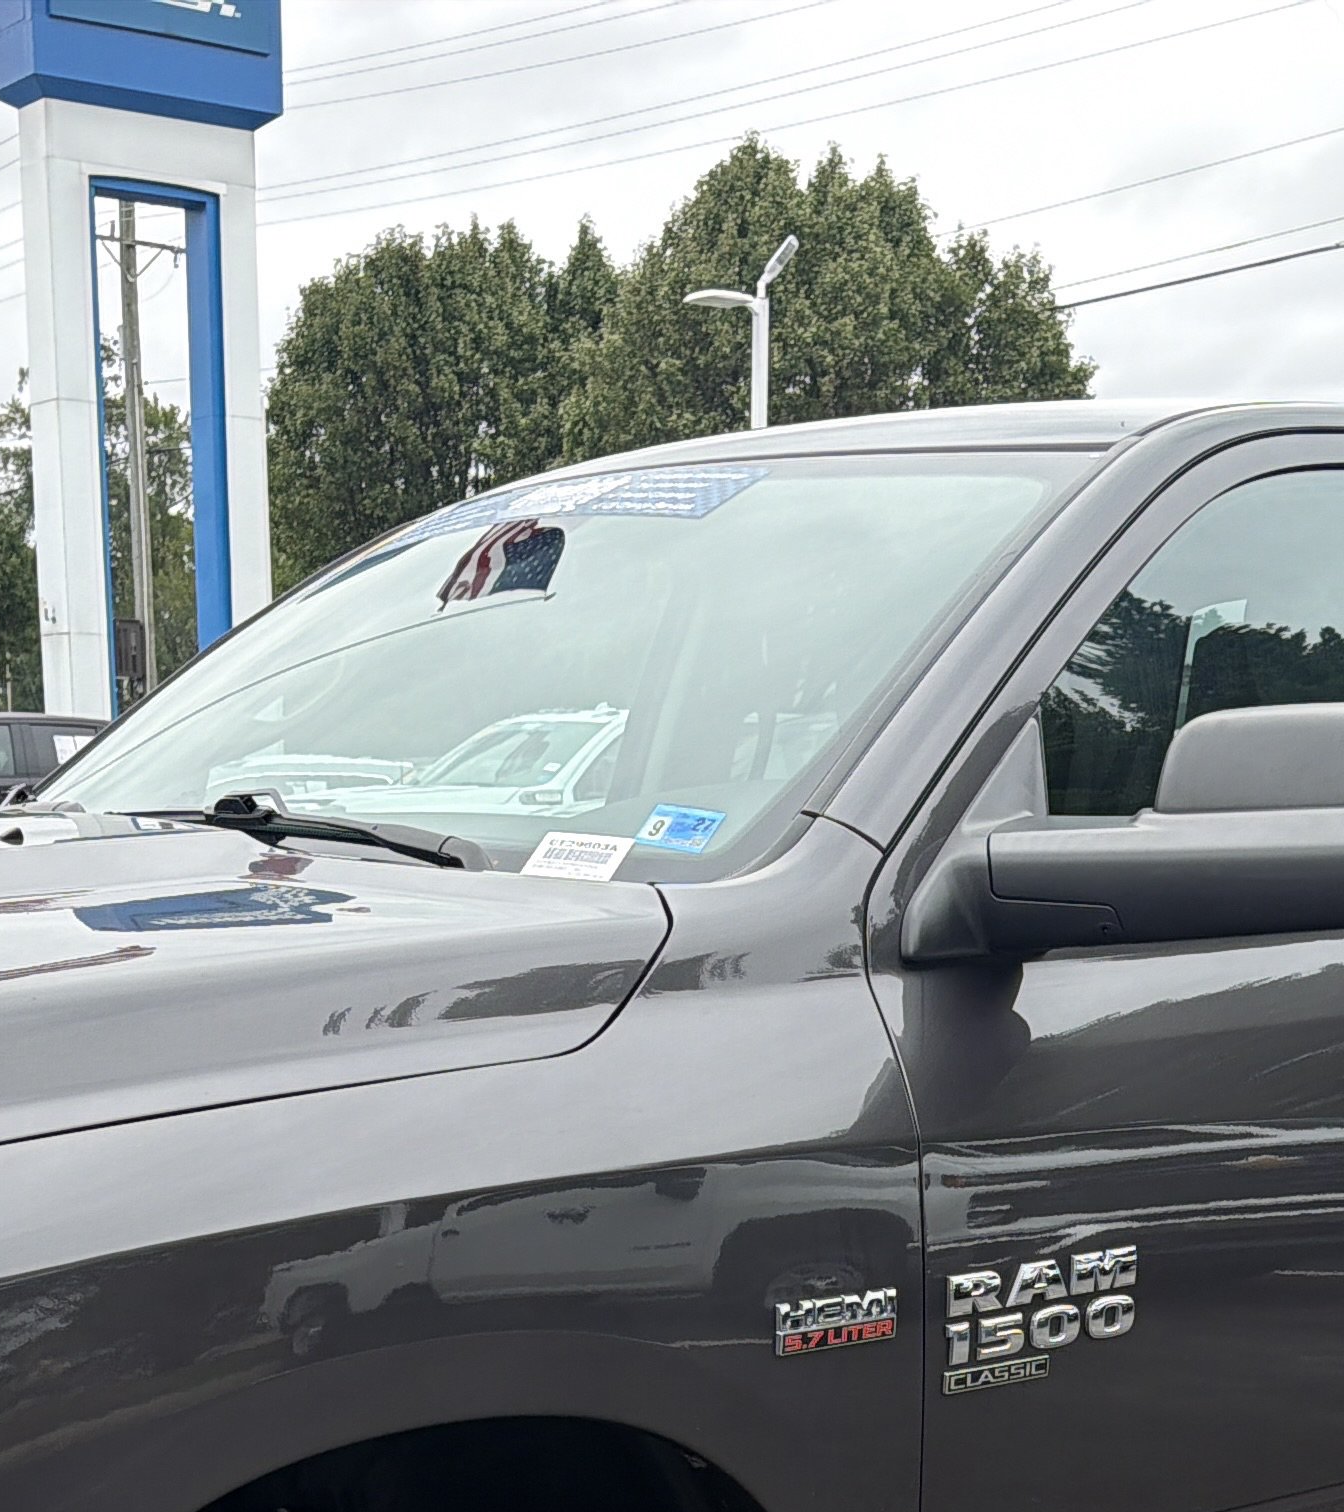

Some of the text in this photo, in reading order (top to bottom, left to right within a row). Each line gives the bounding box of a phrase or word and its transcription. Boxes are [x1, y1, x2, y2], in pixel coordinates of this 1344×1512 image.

[647, 816, 717, 837] 9 27
[946, 1245, 1137, 1318] RAM
[775, 1286, 897, 1333] HEMI
[784, 1319, 893, 1353] 5.7 LITER
[945, 1294, 1136, 1367] 1500
[949, 1360, 1047, 1391] CLASSIC
